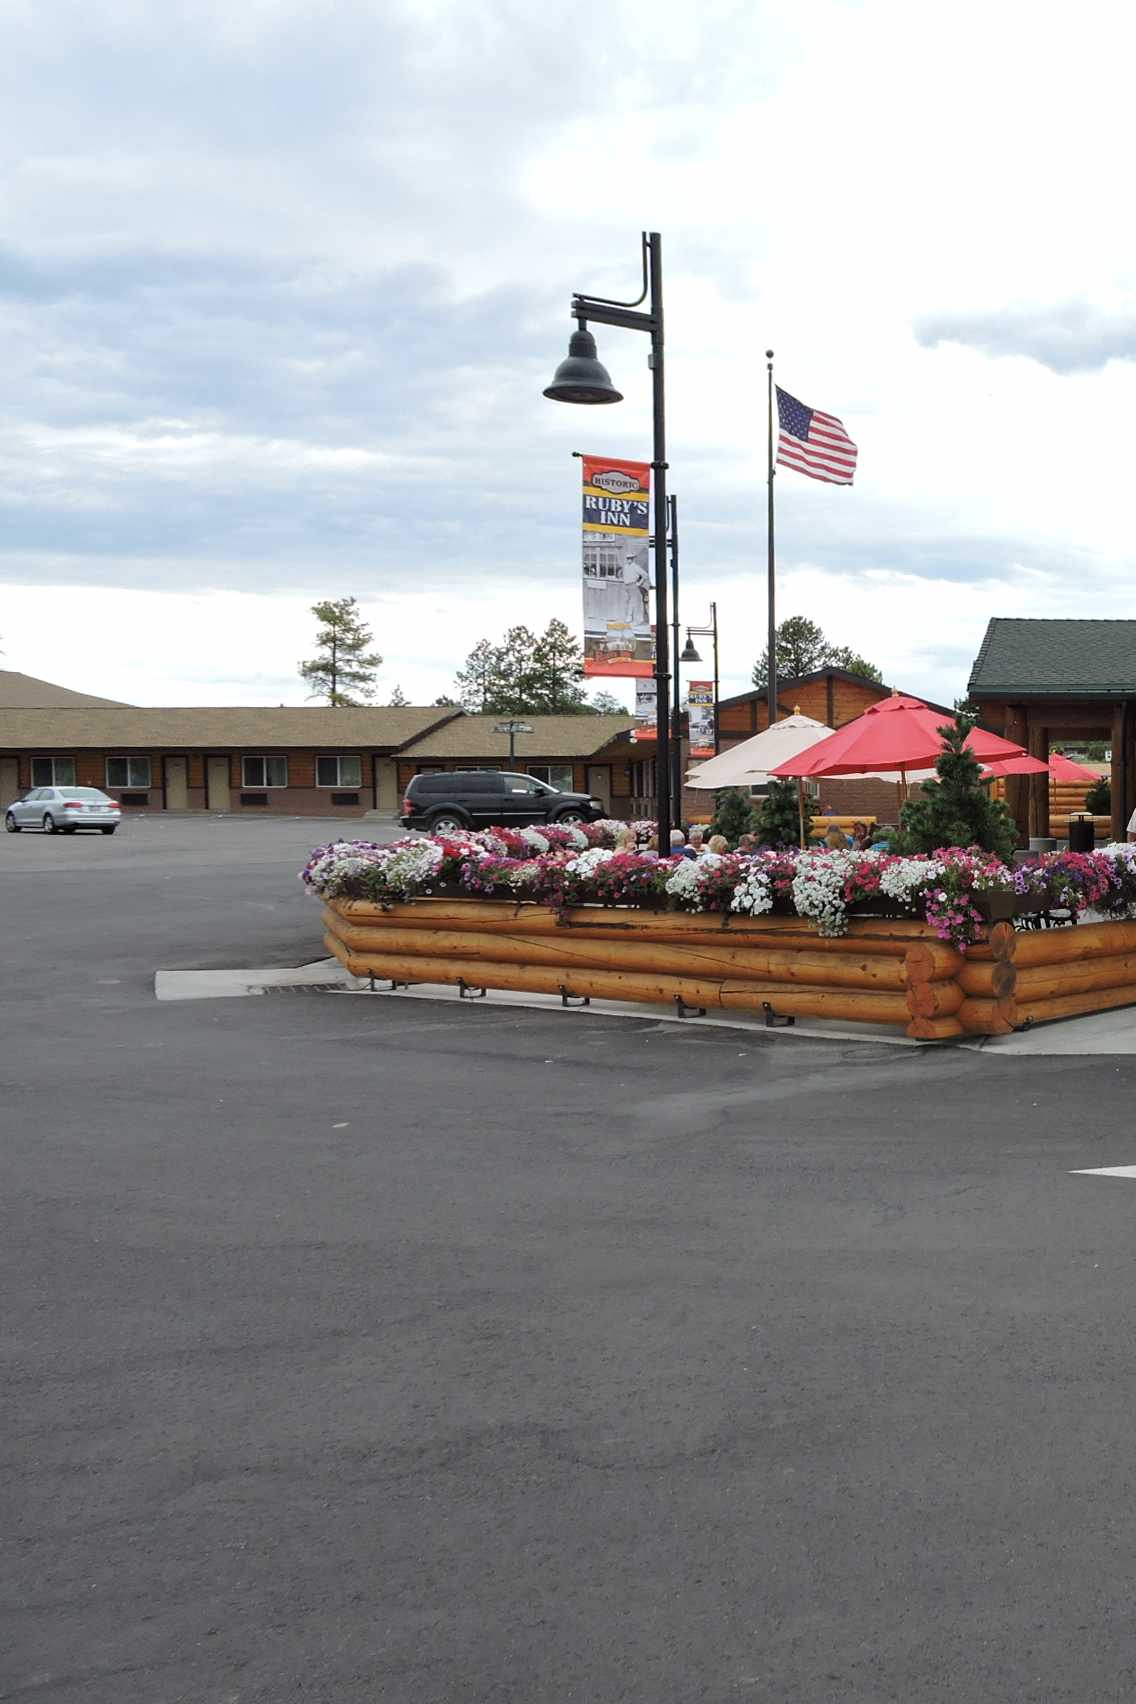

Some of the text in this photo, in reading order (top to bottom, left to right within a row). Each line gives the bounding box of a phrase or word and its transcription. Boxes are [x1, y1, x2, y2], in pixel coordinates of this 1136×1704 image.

[594, 476, 638, 489] HISTORIC
[585, 495, 648, 515] RUBY'S
[600, 511, 631, 526] INN
